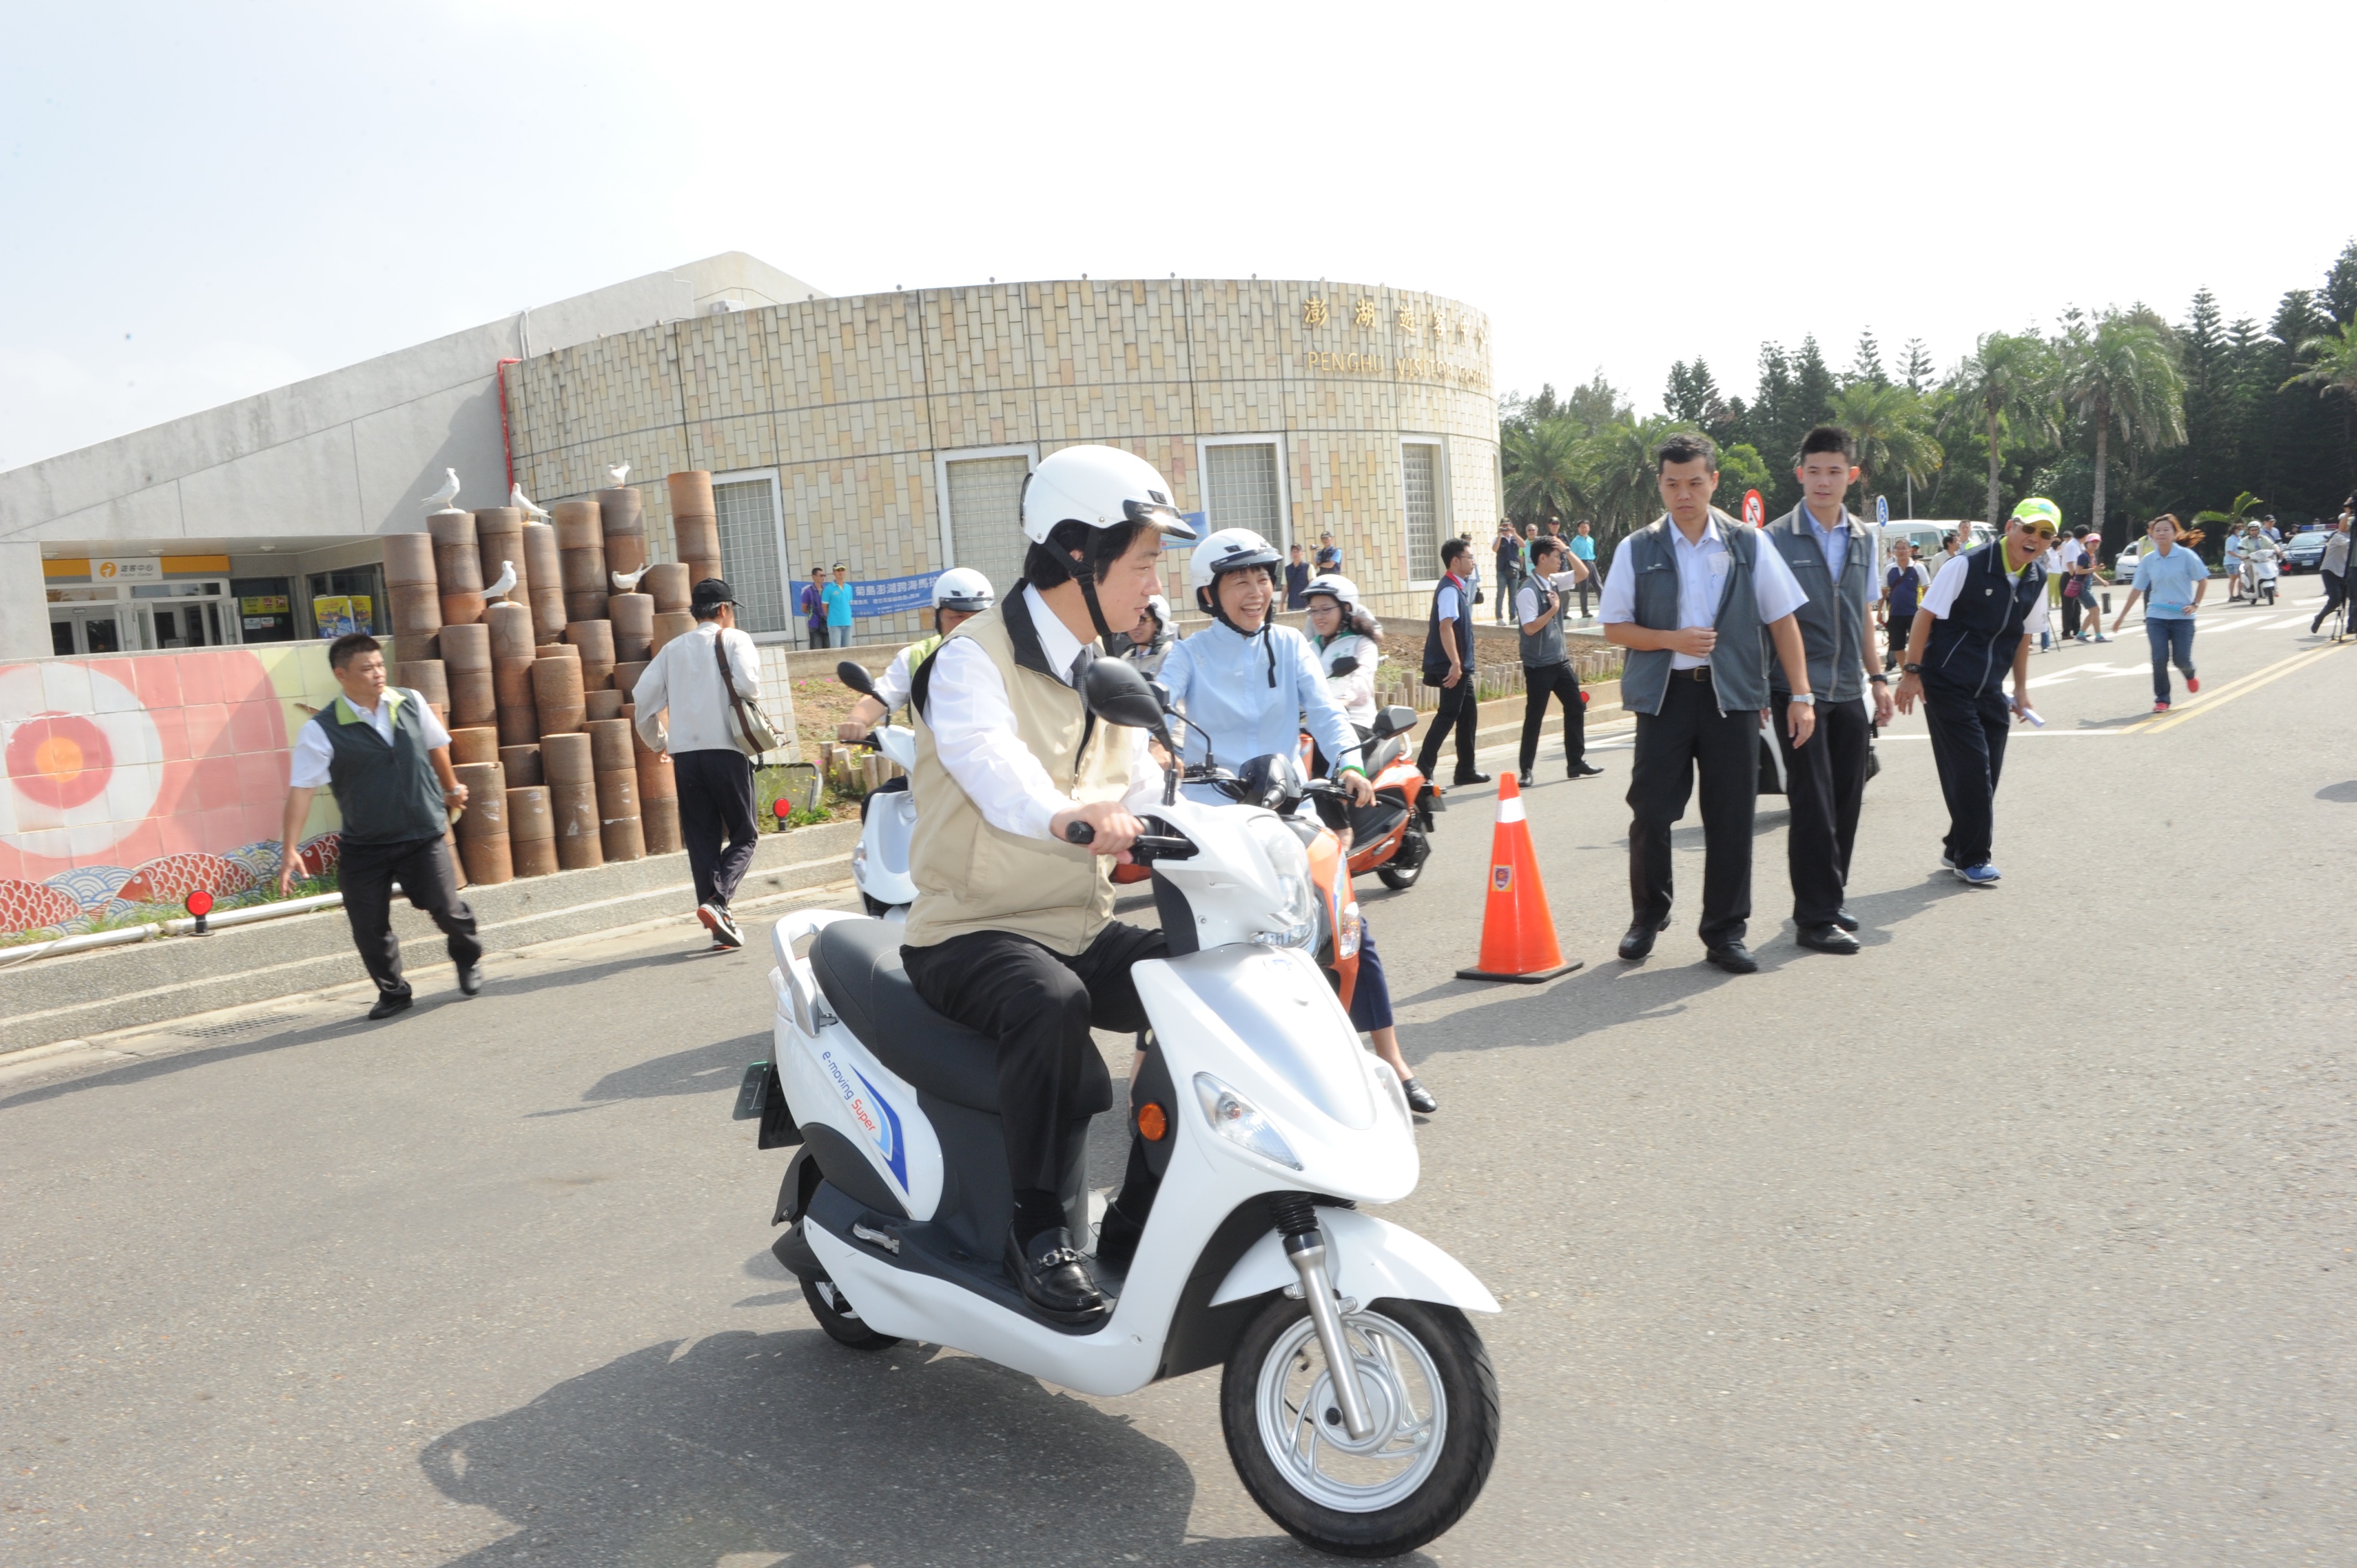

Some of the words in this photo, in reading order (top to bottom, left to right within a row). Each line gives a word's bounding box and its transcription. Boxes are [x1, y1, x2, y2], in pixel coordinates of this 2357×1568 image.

[1304, 295, 1488, 345] 澎湖遊客中心
[1308, 351, 1384, 374] PENGHU
[1396, 358, 1454, 381] VISITOR
[120, 564, 153, 572] 遊客中心
[822, 1051, 854, 1101] e-moving
[851, 1098, 876, 1131] Super
